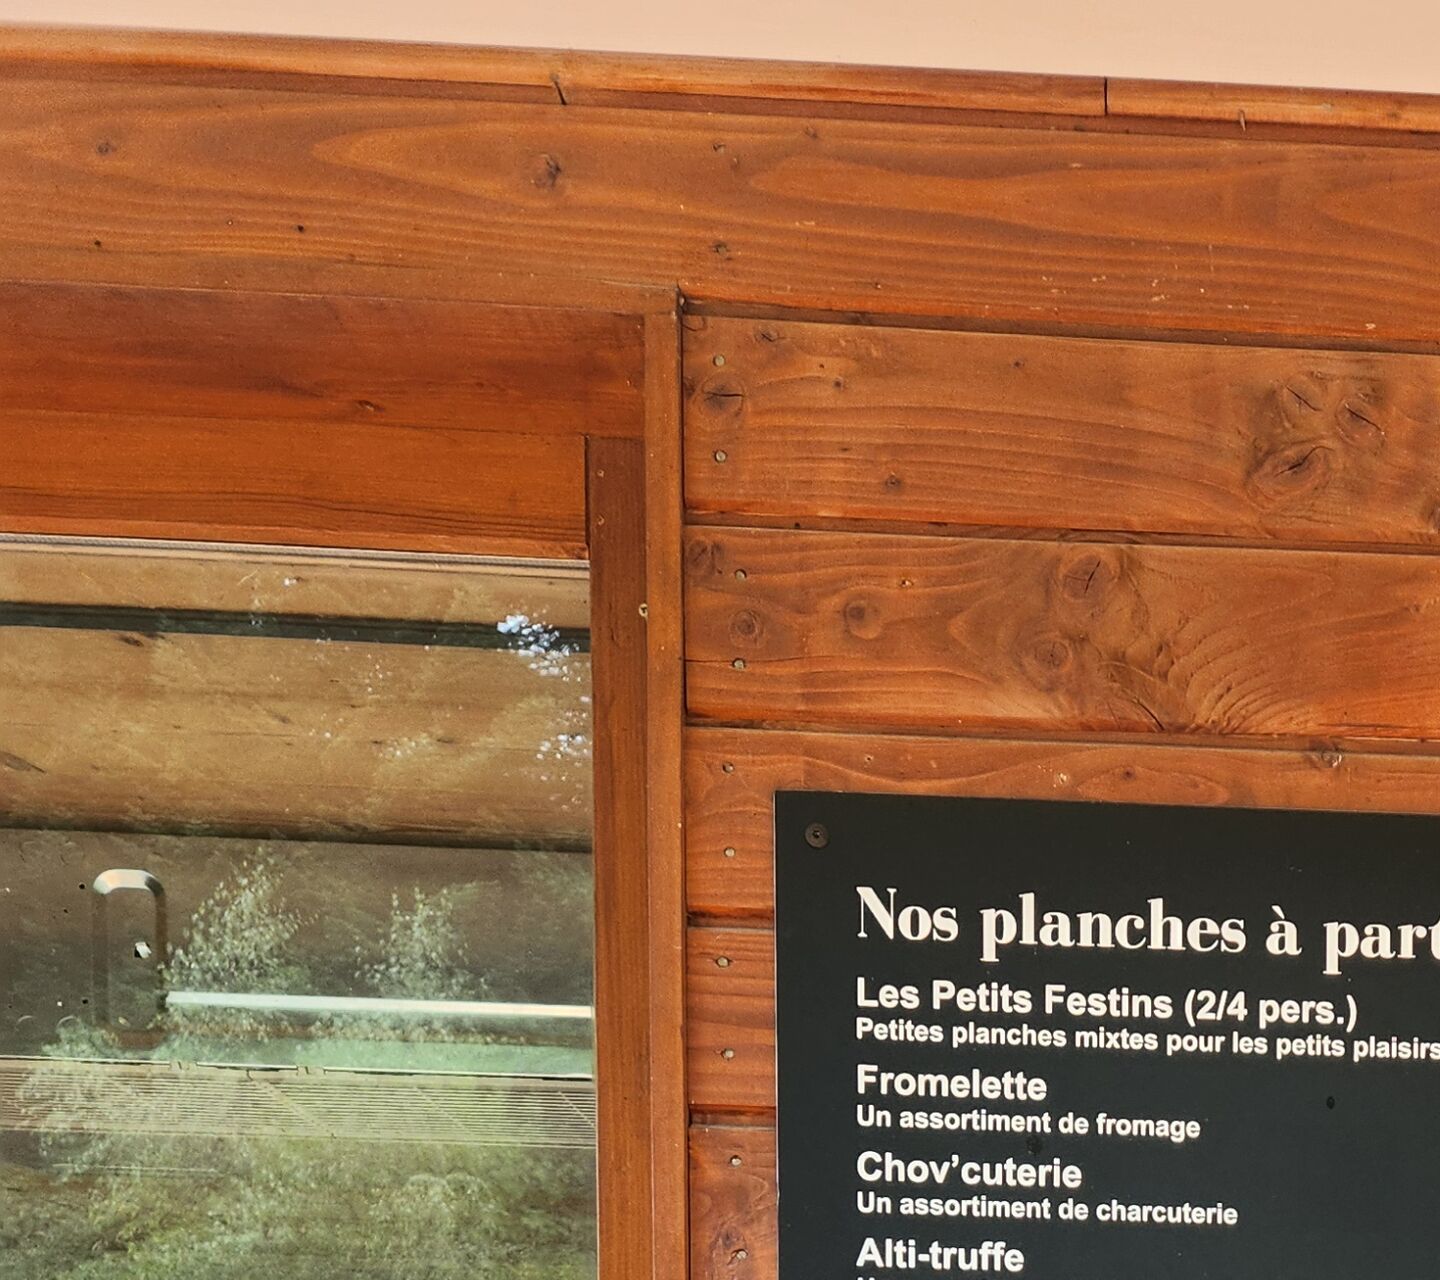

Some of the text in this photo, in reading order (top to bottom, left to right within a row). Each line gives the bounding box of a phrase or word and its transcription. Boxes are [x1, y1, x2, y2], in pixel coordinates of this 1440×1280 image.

[855, 886, 959, 943] Nos
[979, 892, 1247, 963] planches
[1265, 905, 1303, 956] à
[856, 976, 1358, 1034] Les Petits Festins (2/4 pers.)
[856, 1016, 945, 1043] Petites
[952, 1021, 1068, 1049] planches
[1074, 1025, 1159, 1051] mixtes
[1166, 1033, 1226, 1057] pour
[1232, 1030, 1269, 1055] les
[1275, 1033, 1346, 1061] petits
[856, 1063, 1048, 1102] Fromelette
[856, 1104, 1201, 1144] Un assortiment de fromage
[855, 1237, 1025, 1273] Alti-truffe
